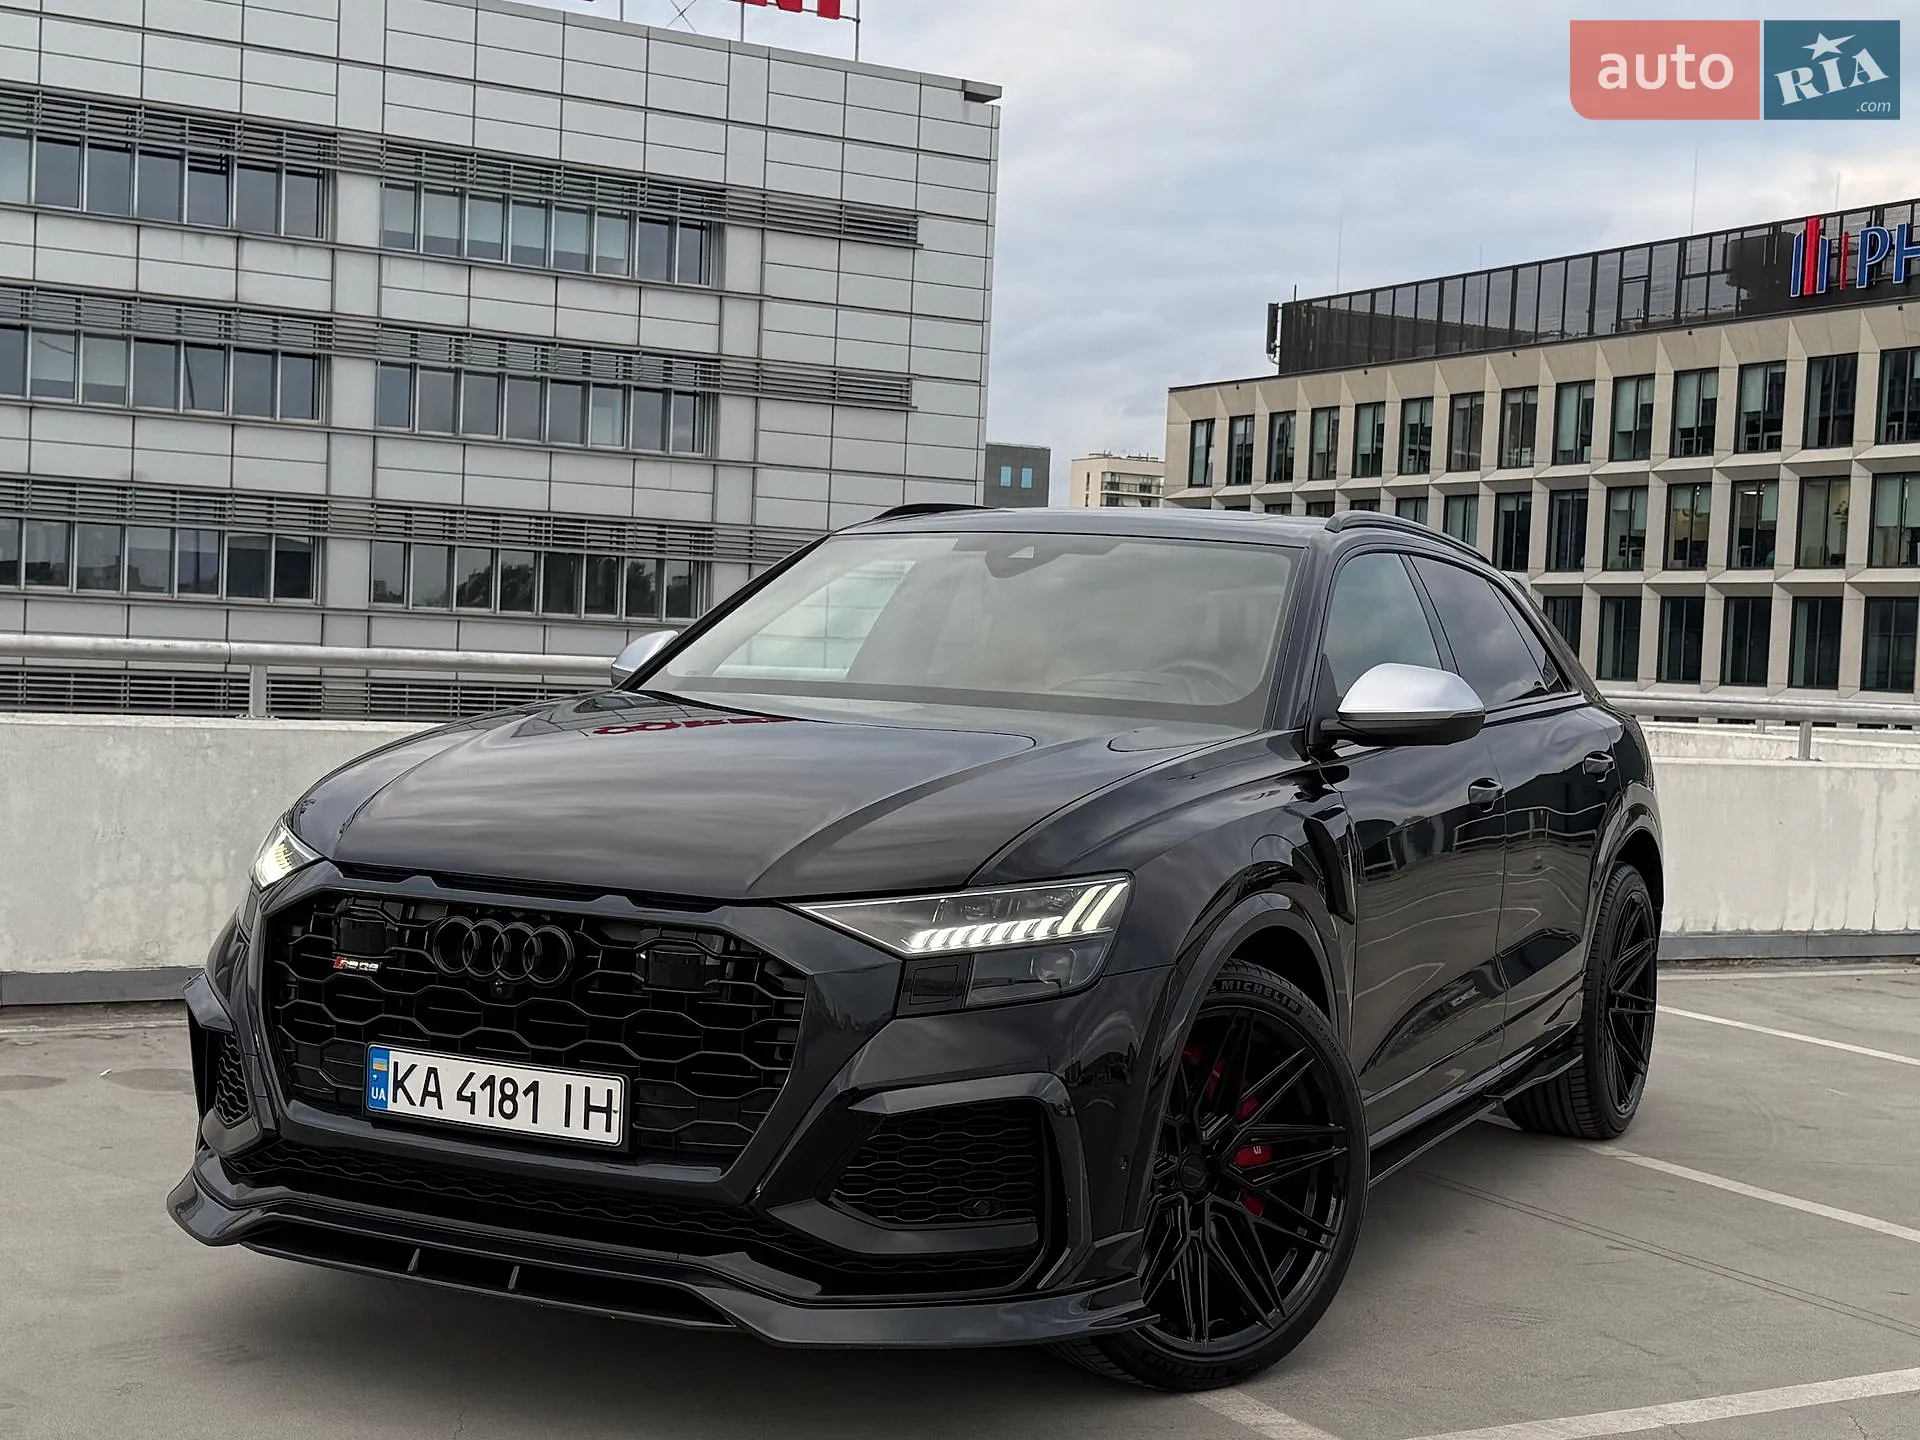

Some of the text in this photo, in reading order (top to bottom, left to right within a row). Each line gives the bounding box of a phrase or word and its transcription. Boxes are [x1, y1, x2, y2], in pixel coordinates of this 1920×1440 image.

[1221, 980, 1300, 1012] MICHELIN
[371, 1087, 387, 1101] UA
[392, 1061, 613, 1133] KA 4181 IH
